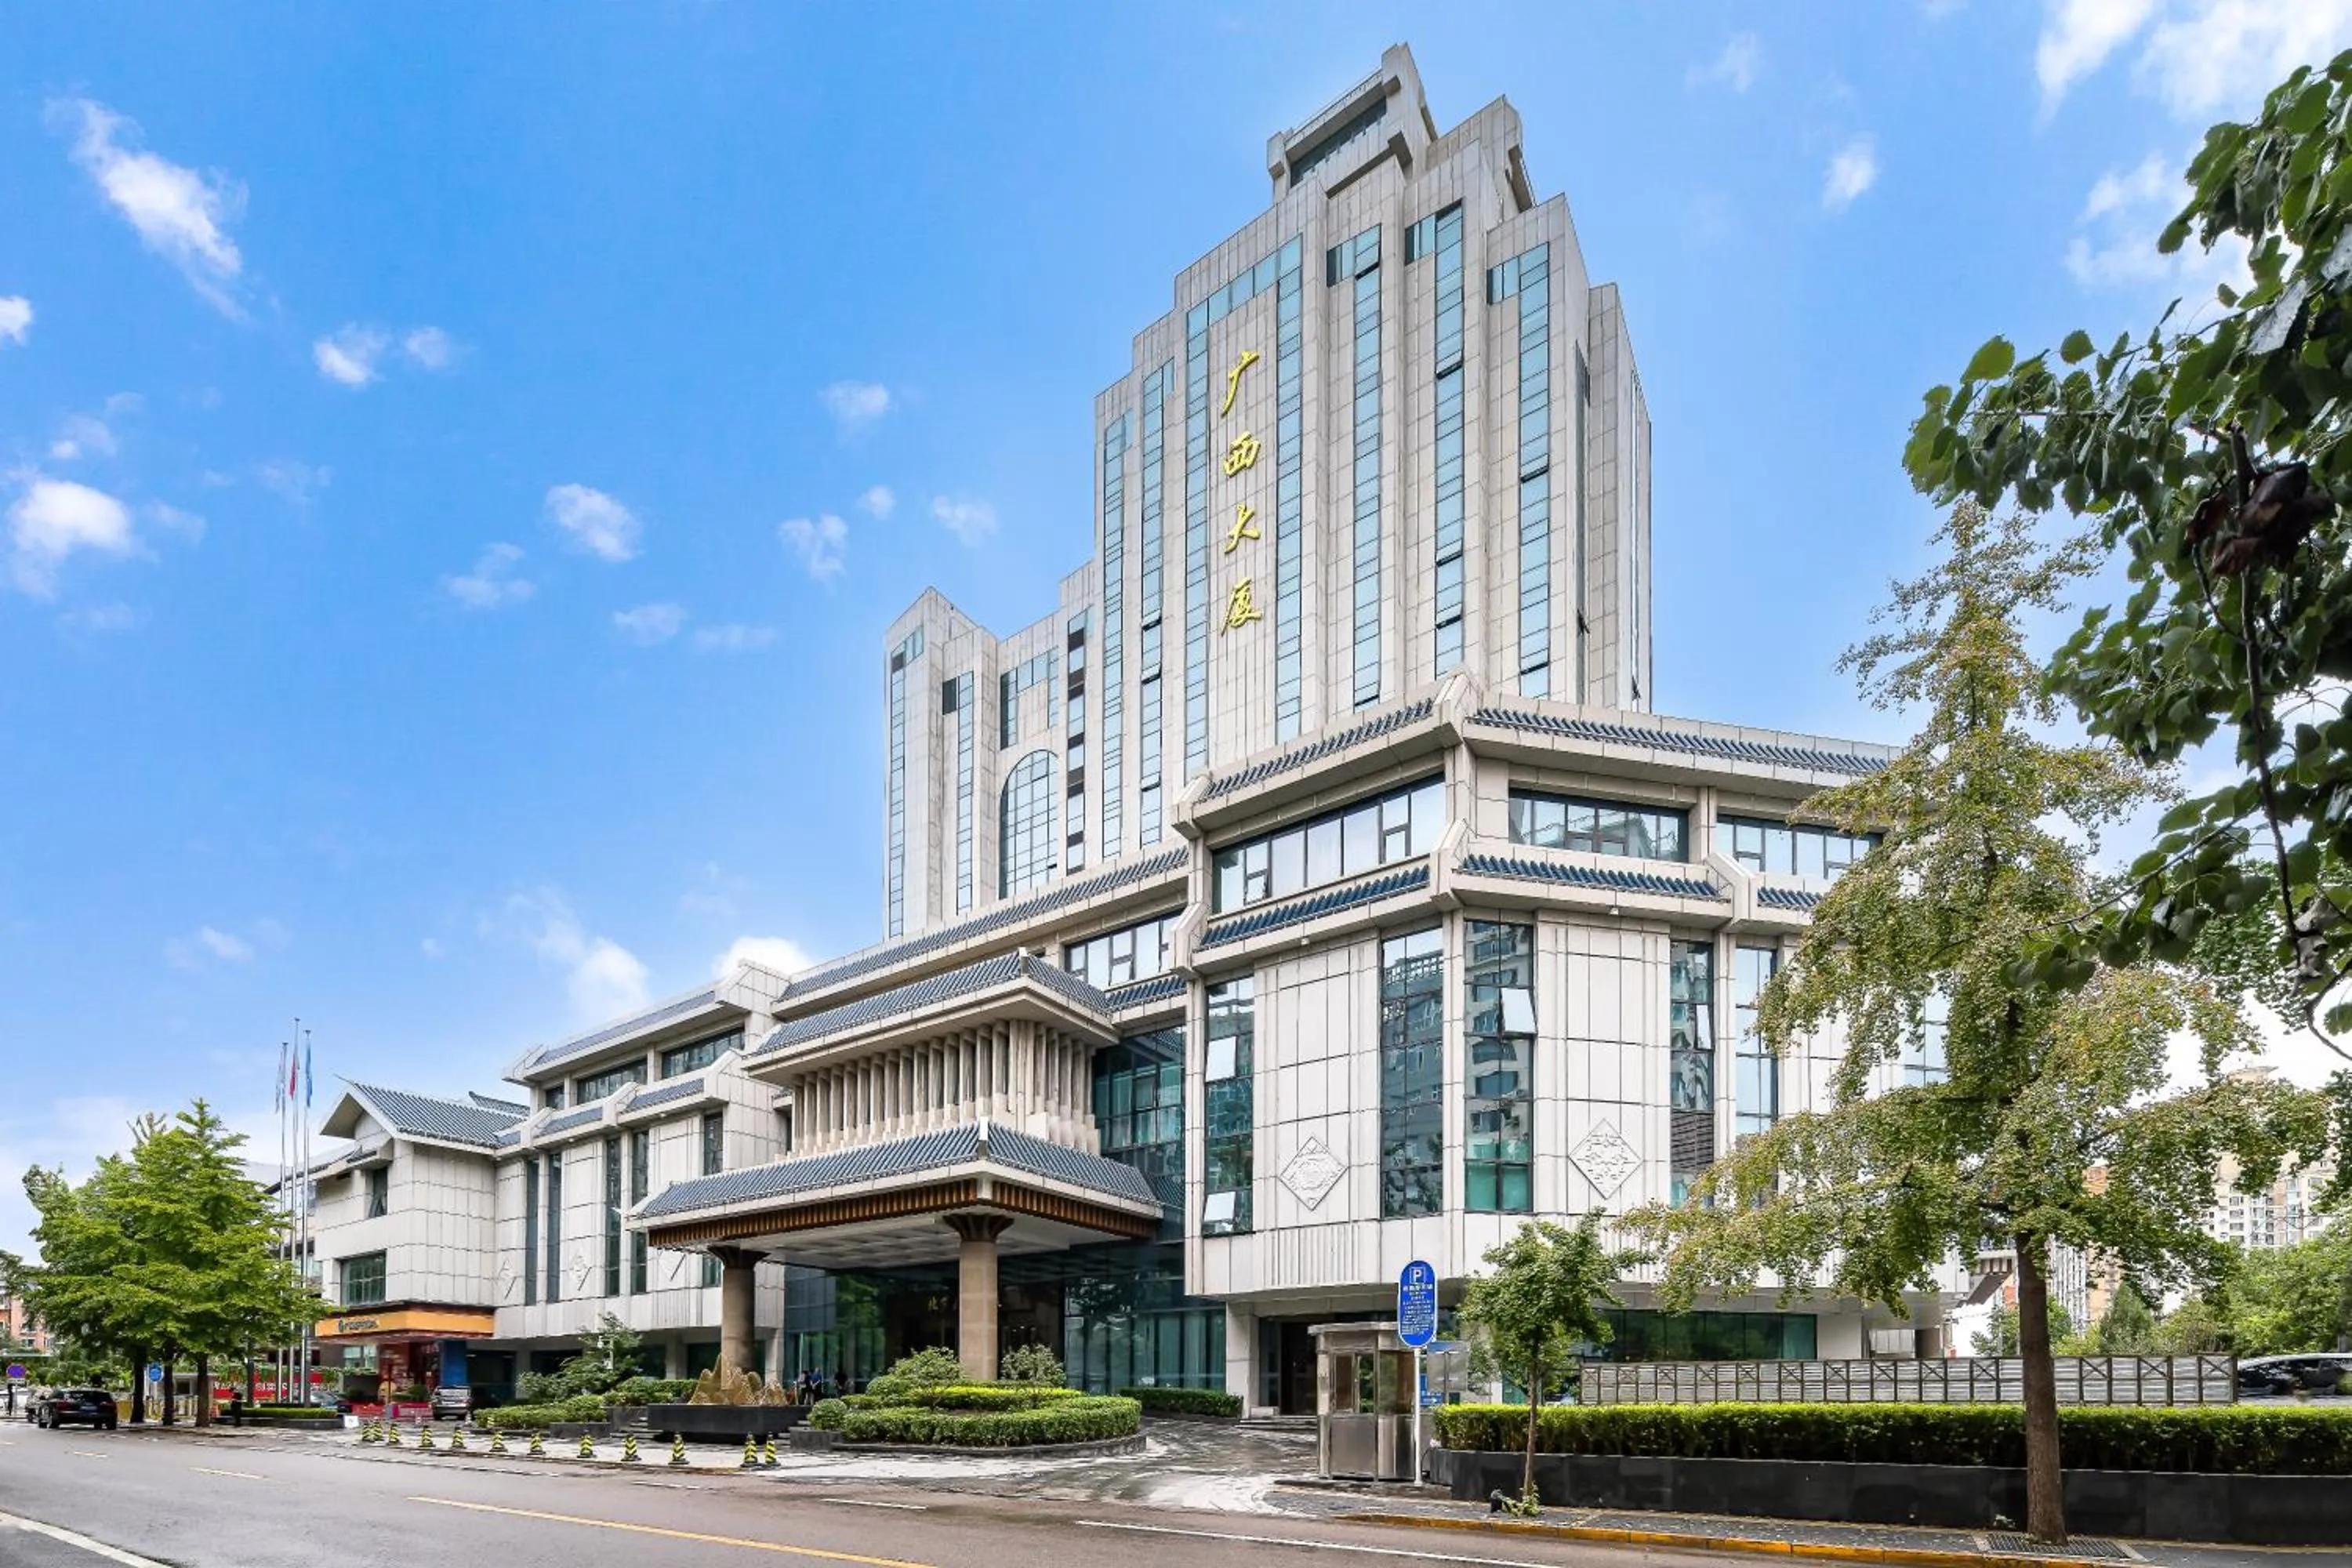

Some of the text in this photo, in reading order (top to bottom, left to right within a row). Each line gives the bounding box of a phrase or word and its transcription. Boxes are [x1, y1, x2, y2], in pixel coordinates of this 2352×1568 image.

[1220, 349, 1263, 637] 广西大厦
[1413, 1269, 1423, 1283] P
